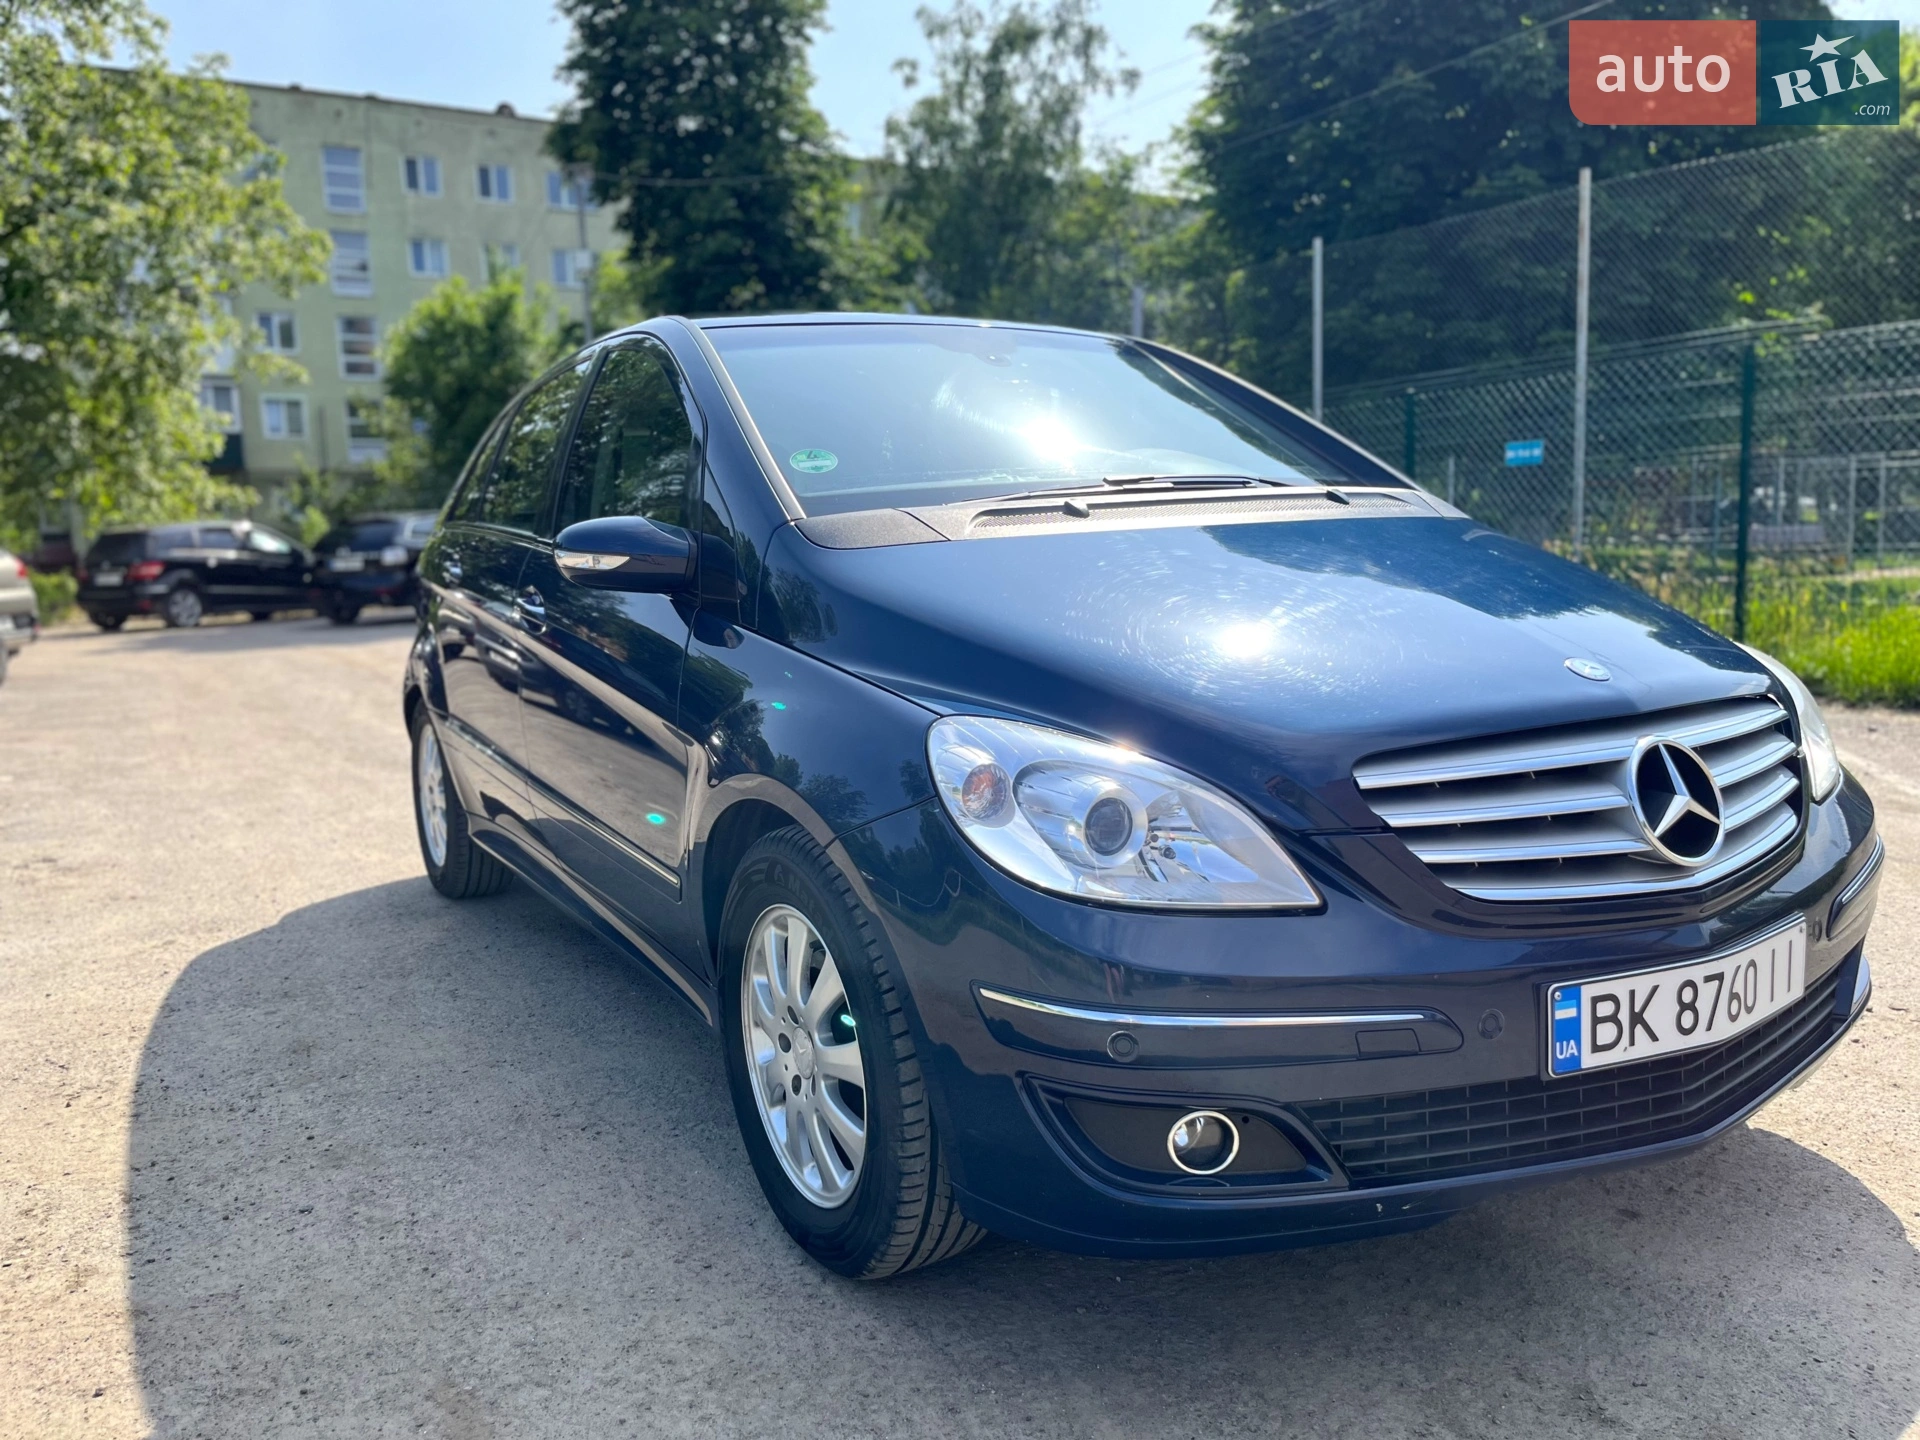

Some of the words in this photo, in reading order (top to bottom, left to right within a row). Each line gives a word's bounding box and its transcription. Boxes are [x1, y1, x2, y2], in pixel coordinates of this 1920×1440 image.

[1590, 984, 1660, 1054] BK
[1675, 958, 1758, 1037] 8760
[1770, 940, 1793, 1003] II
[1556, 1039, 1579, 1060] UA
